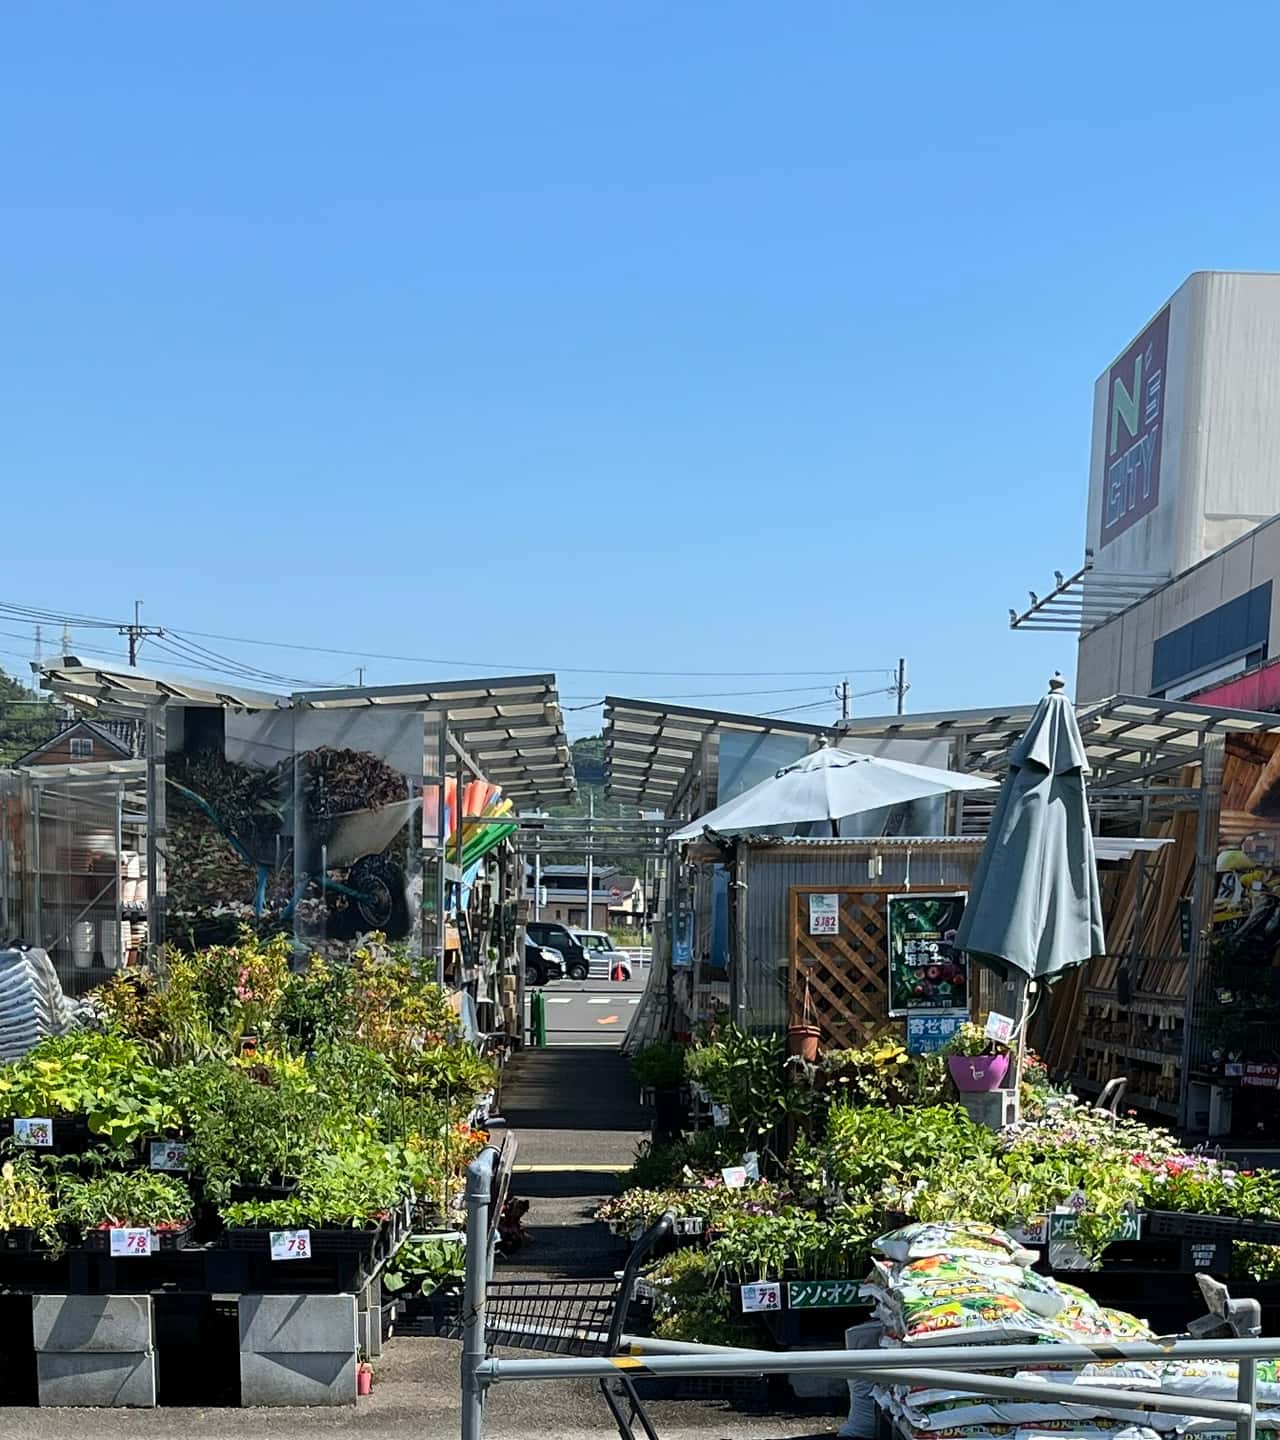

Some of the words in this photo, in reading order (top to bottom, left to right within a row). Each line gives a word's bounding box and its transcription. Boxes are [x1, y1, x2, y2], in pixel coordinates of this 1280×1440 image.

[1105, 423, 1159, 529] CITY
[127, 1236, 147, 1248] 78
[287, 1239, 306, 1252] 78
[758, 1292, 777, 1304] 78
